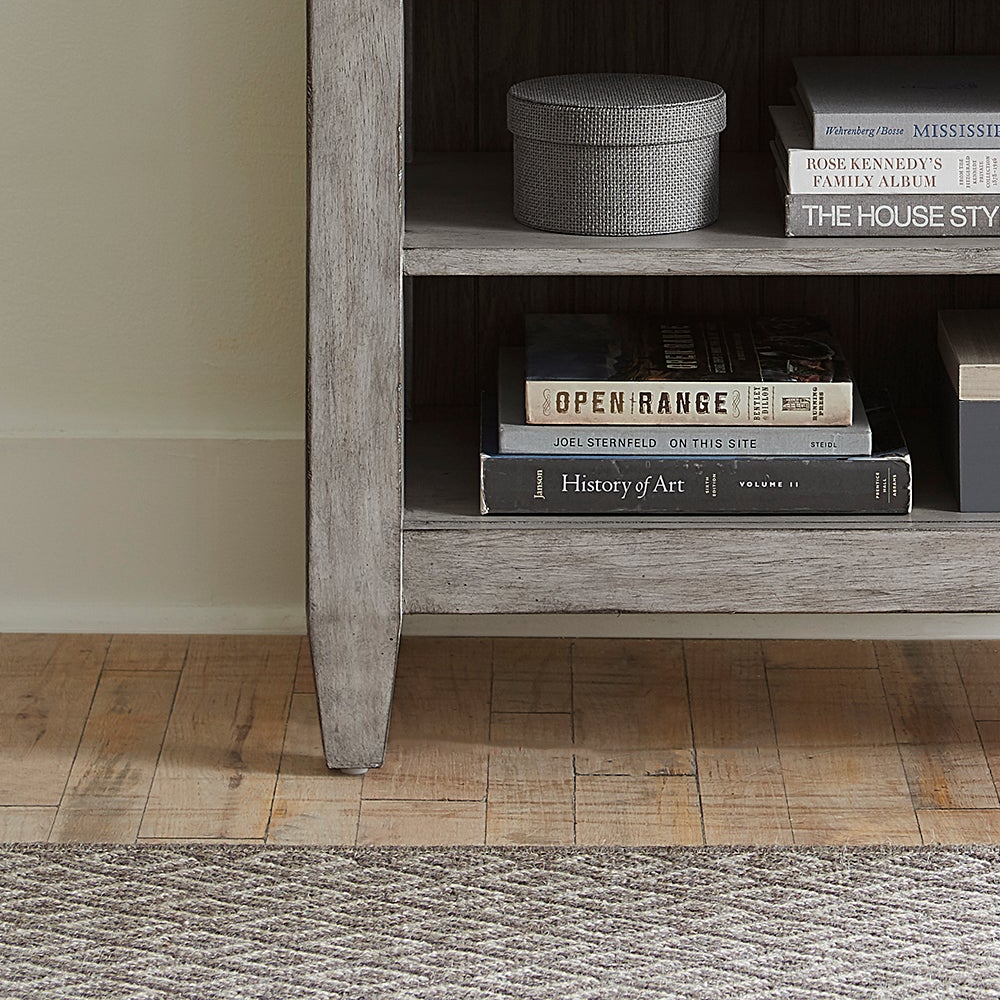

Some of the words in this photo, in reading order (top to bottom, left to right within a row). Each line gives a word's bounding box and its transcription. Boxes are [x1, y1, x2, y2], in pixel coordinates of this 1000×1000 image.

[807, 158, 846, 170] ROSE
[813, 175, 873, 188] FAMILY
[878, 175, 937, 188] ALBUM
[802, 205, 852, 227] THE
[858, 205, 945, 227] HOUSE
[556, 391, 625, 414] OPEN
[639, 391, 728, 414] RANGE
[753, 386, 761, 421] BENTLEY
[553, 437, 583, 447] JOEL
[587, 437, 657, 448] STERNFELD
[669, 438, 687, 448] ON
[693, 438, 723, 448] THIS
[728, 438, 757, 448] SITE
[533, 469, 546, 499] Janson
[561, 473, 632, 499] History
[635, 475, 652, 499] of
[652, 474, 685, 493] Art
